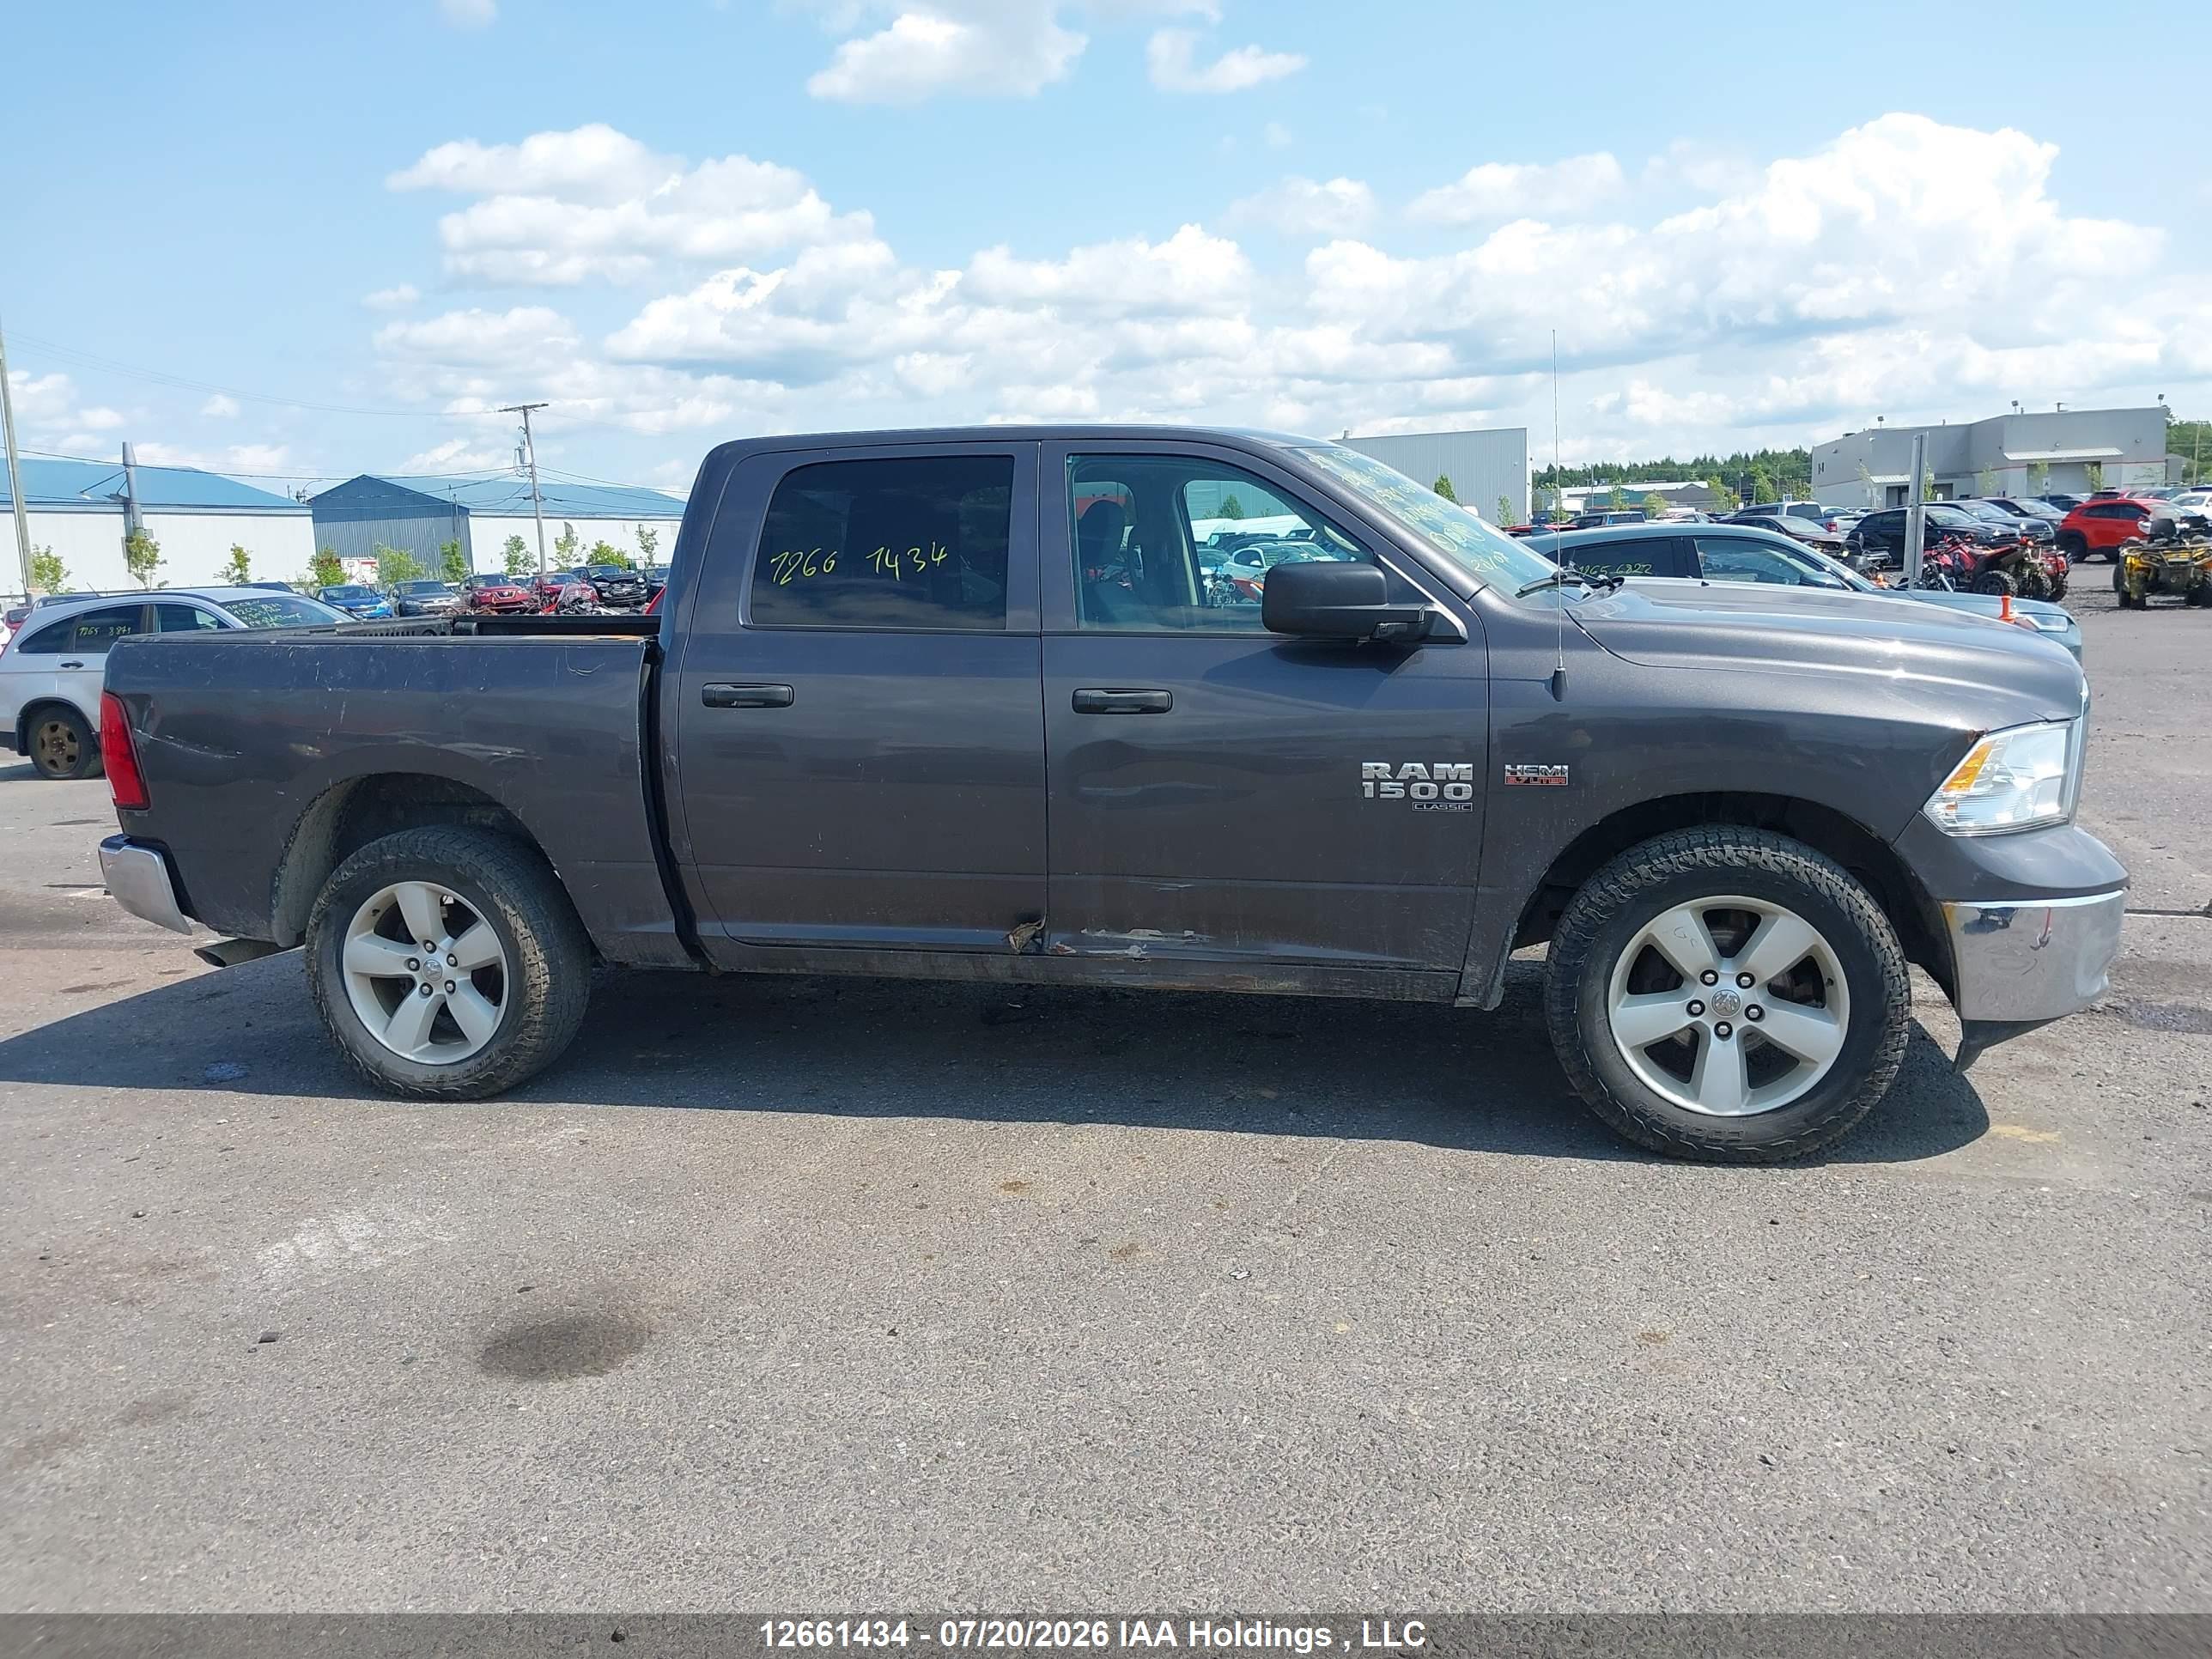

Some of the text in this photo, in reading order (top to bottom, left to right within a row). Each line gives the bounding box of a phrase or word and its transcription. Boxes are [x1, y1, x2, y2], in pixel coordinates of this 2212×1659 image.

[866, 541, 948, 581] 1434
[1361, 762, 1474, 781] RAM
[1504, 764, 1569, 776] HEMI
[1362, 781, 1474, 800] 1500
[1636, 1100, 1746, 1140] COOPER
